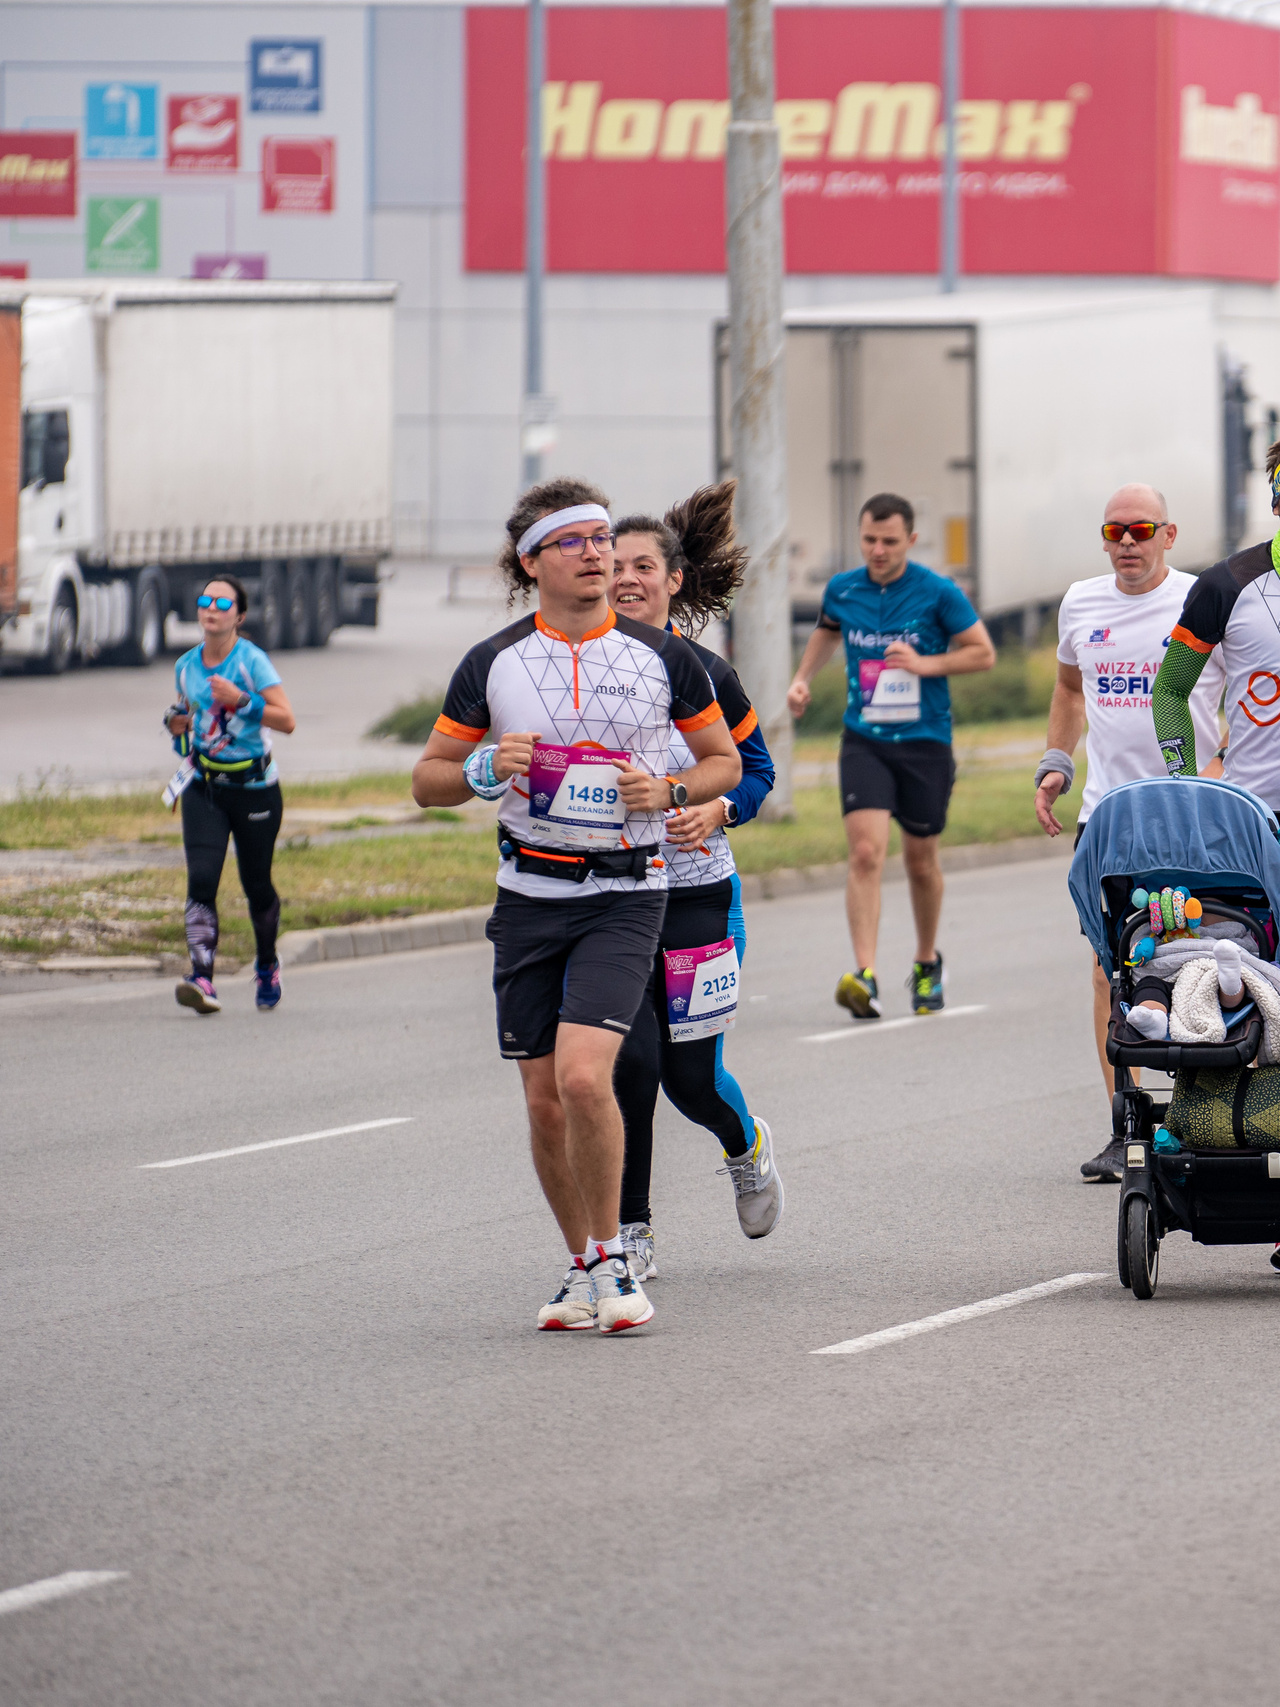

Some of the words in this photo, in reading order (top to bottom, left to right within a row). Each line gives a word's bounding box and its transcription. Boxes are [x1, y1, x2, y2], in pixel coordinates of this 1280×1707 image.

[526, 81, 1076, 162] HomeMax
[1095, 662, 1136, 675] WIZZ
[595, 683, 637, 697] modis
[1097, 675, 1154, 694] SOFI
[1097, 697, 1152, 708] MARATH
[568, 784, 618, 805] 1489
[567, 805, 615, 815] ALEXANDAR
[702, 971, 736, 996] 2123
[715, 994, 730, 1003] YOVA
